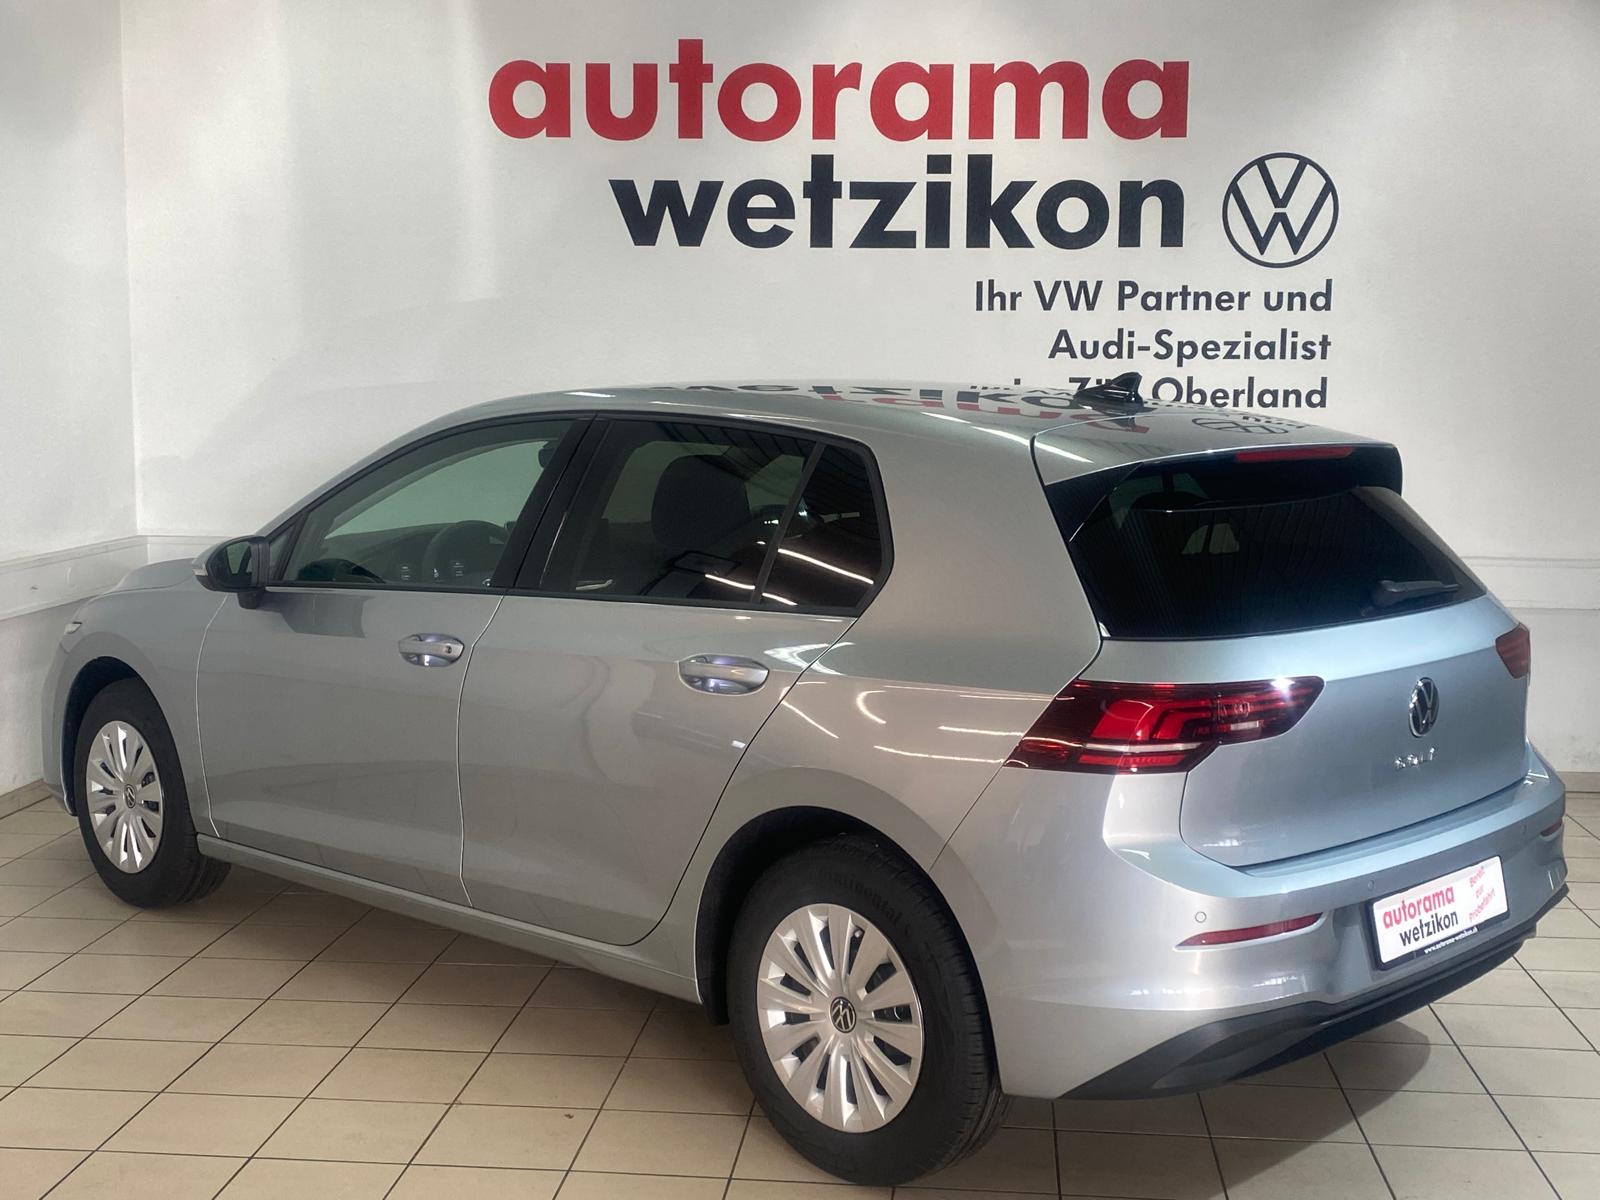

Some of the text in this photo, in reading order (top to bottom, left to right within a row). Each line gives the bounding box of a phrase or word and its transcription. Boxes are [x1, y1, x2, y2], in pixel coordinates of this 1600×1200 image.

[489, 40, 1188, 141] autorama
[609, 154, 1184, 250] wetzikon
[976, 279, 1332, 311] Ihr VW Partner und
[1048, 328, 1331, 367] Audi-Spezialist
[1152, 376, 1327, 408] Oberland
[1383, 886, 1455, 929] autorama
[1399, 910, 1459, 947] wetzikon
